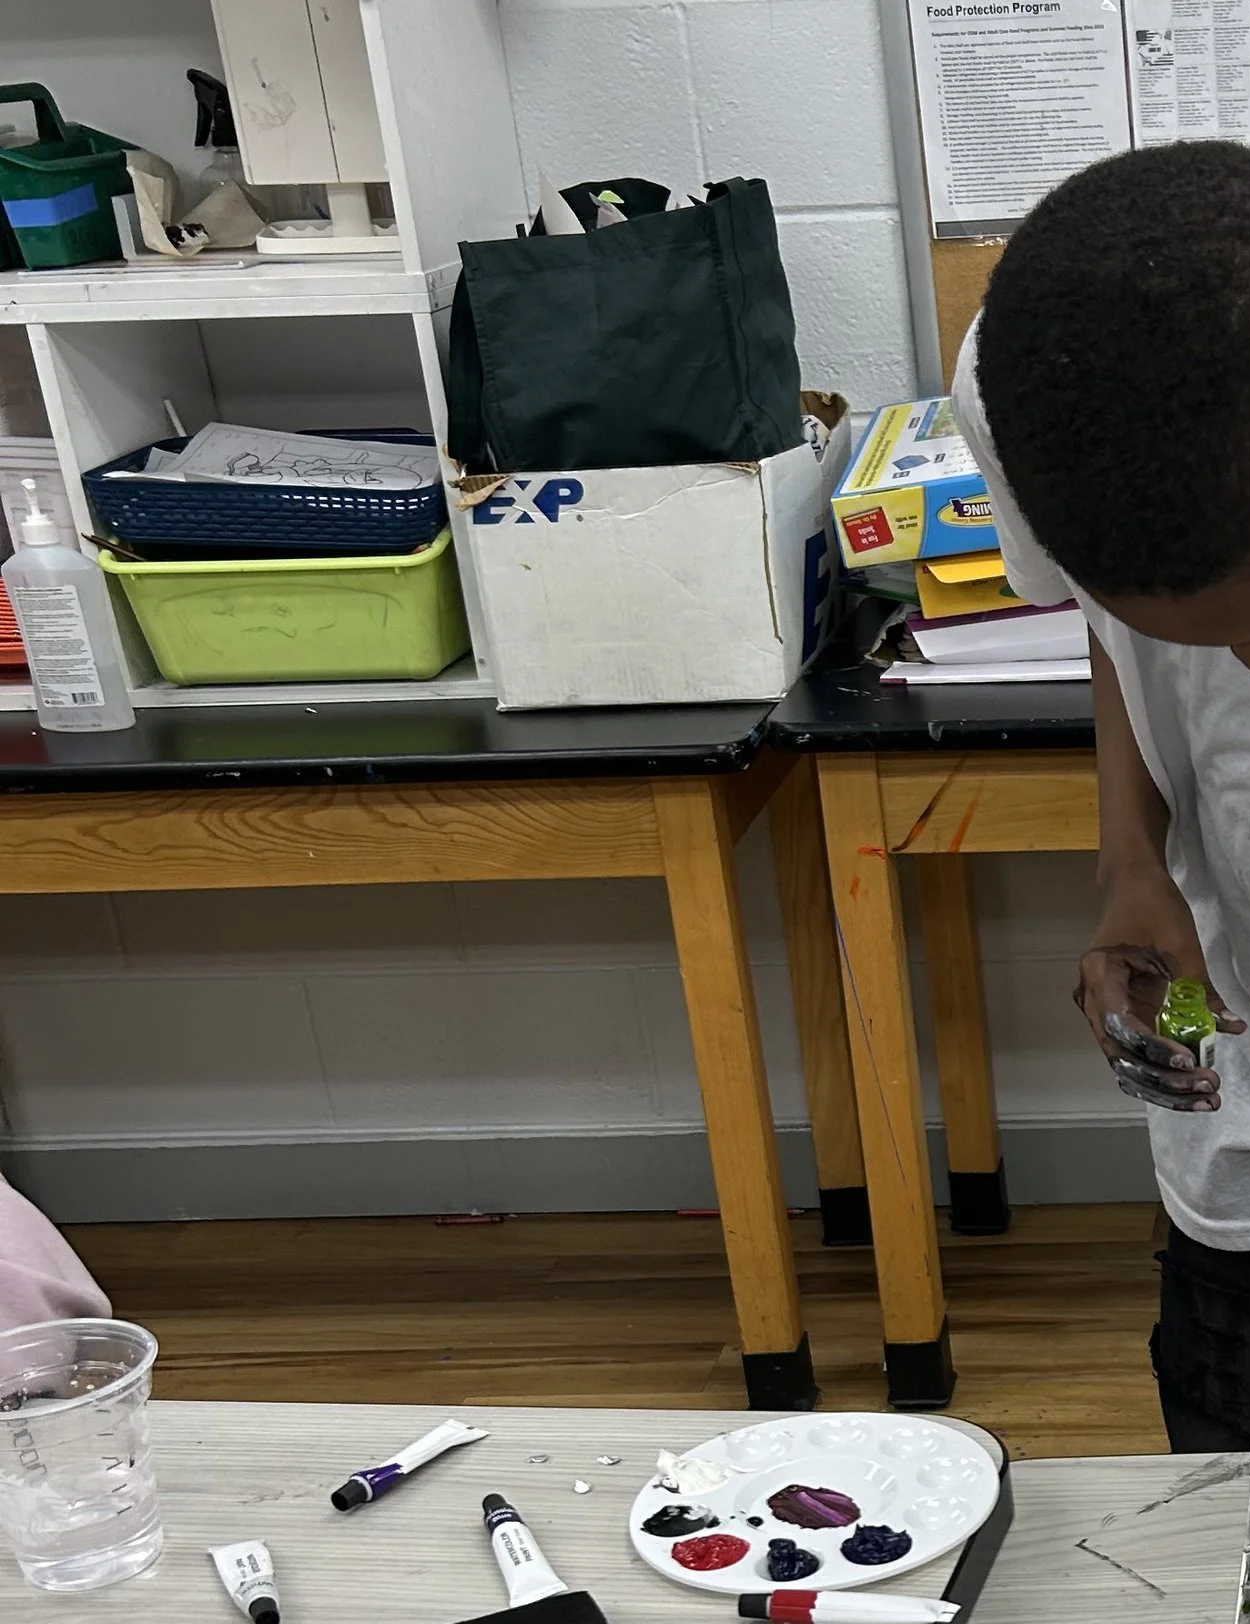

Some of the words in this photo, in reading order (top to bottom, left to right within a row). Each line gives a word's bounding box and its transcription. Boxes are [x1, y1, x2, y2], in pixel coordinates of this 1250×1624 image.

[927, 5, 954, 17] Food
[955, 3, 1010, 16] Protection
[1012, 1, 1061, 15] Program
[473, 478, 584, 525] EXP
